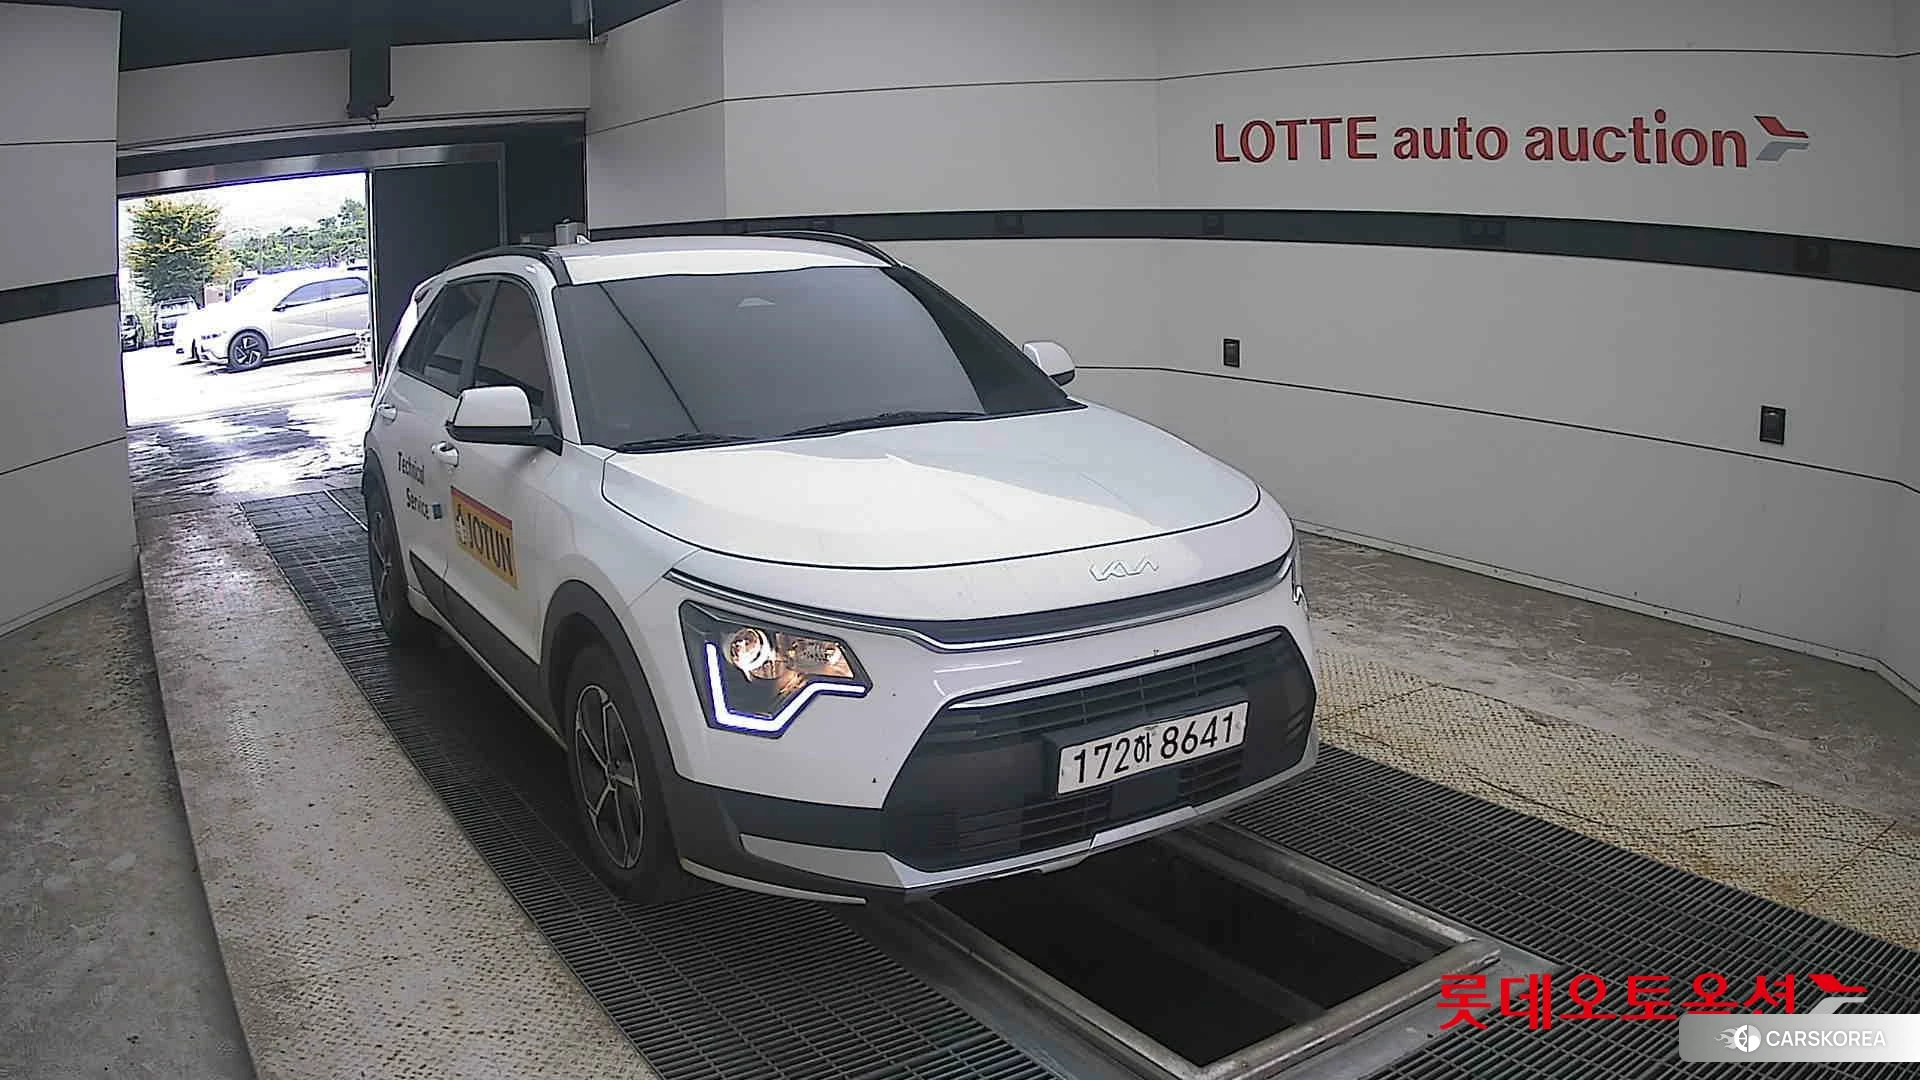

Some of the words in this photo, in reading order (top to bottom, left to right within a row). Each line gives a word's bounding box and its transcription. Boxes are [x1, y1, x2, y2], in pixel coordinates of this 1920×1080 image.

[1215, 115, 1378, 163] LOTTE
[1393, 116, 1509, 161] auto
[1524, 108, 1748, 168] auction
[397, 450, 425, 485] Technical
[405, 487, 430, 520] Service
[466, 512, 514, 577] JOTUN
[1074, 731, 1152, 784] 172하
[1160, 711, 1233, 760] 8641
